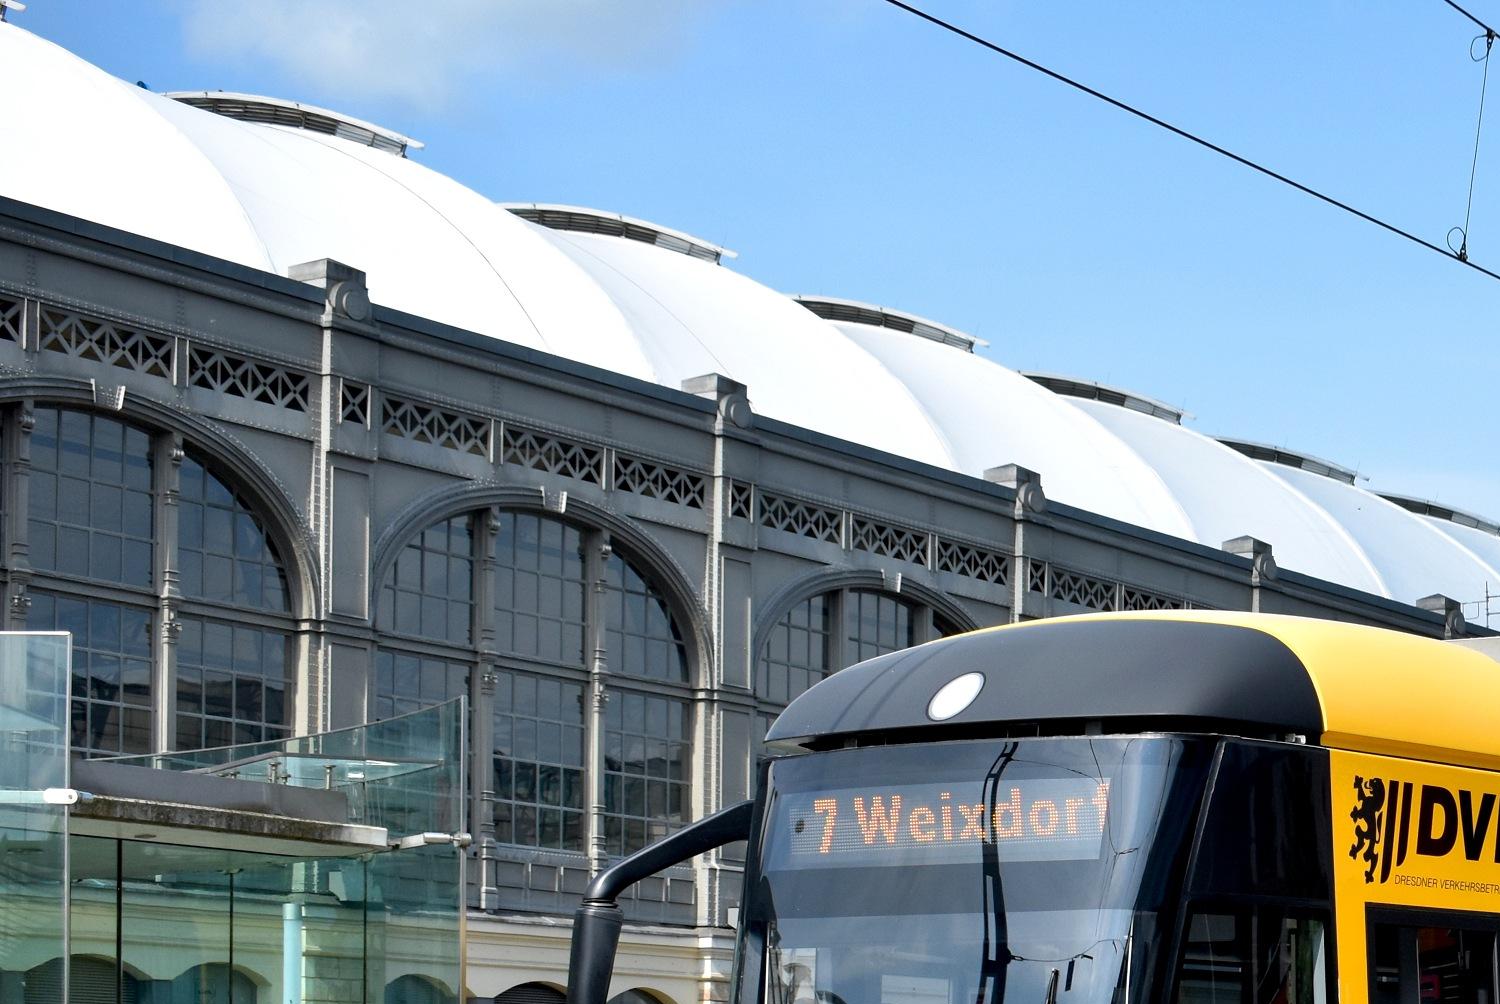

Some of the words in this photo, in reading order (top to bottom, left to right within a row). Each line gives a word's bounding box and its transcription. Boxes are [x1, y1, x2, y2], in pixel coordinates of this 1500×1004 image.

[813, 799, 838, 853] 7
[854, 783, 1109, 845] Weixdorf
[1394, 874, 1438, 888] DRESDNER
